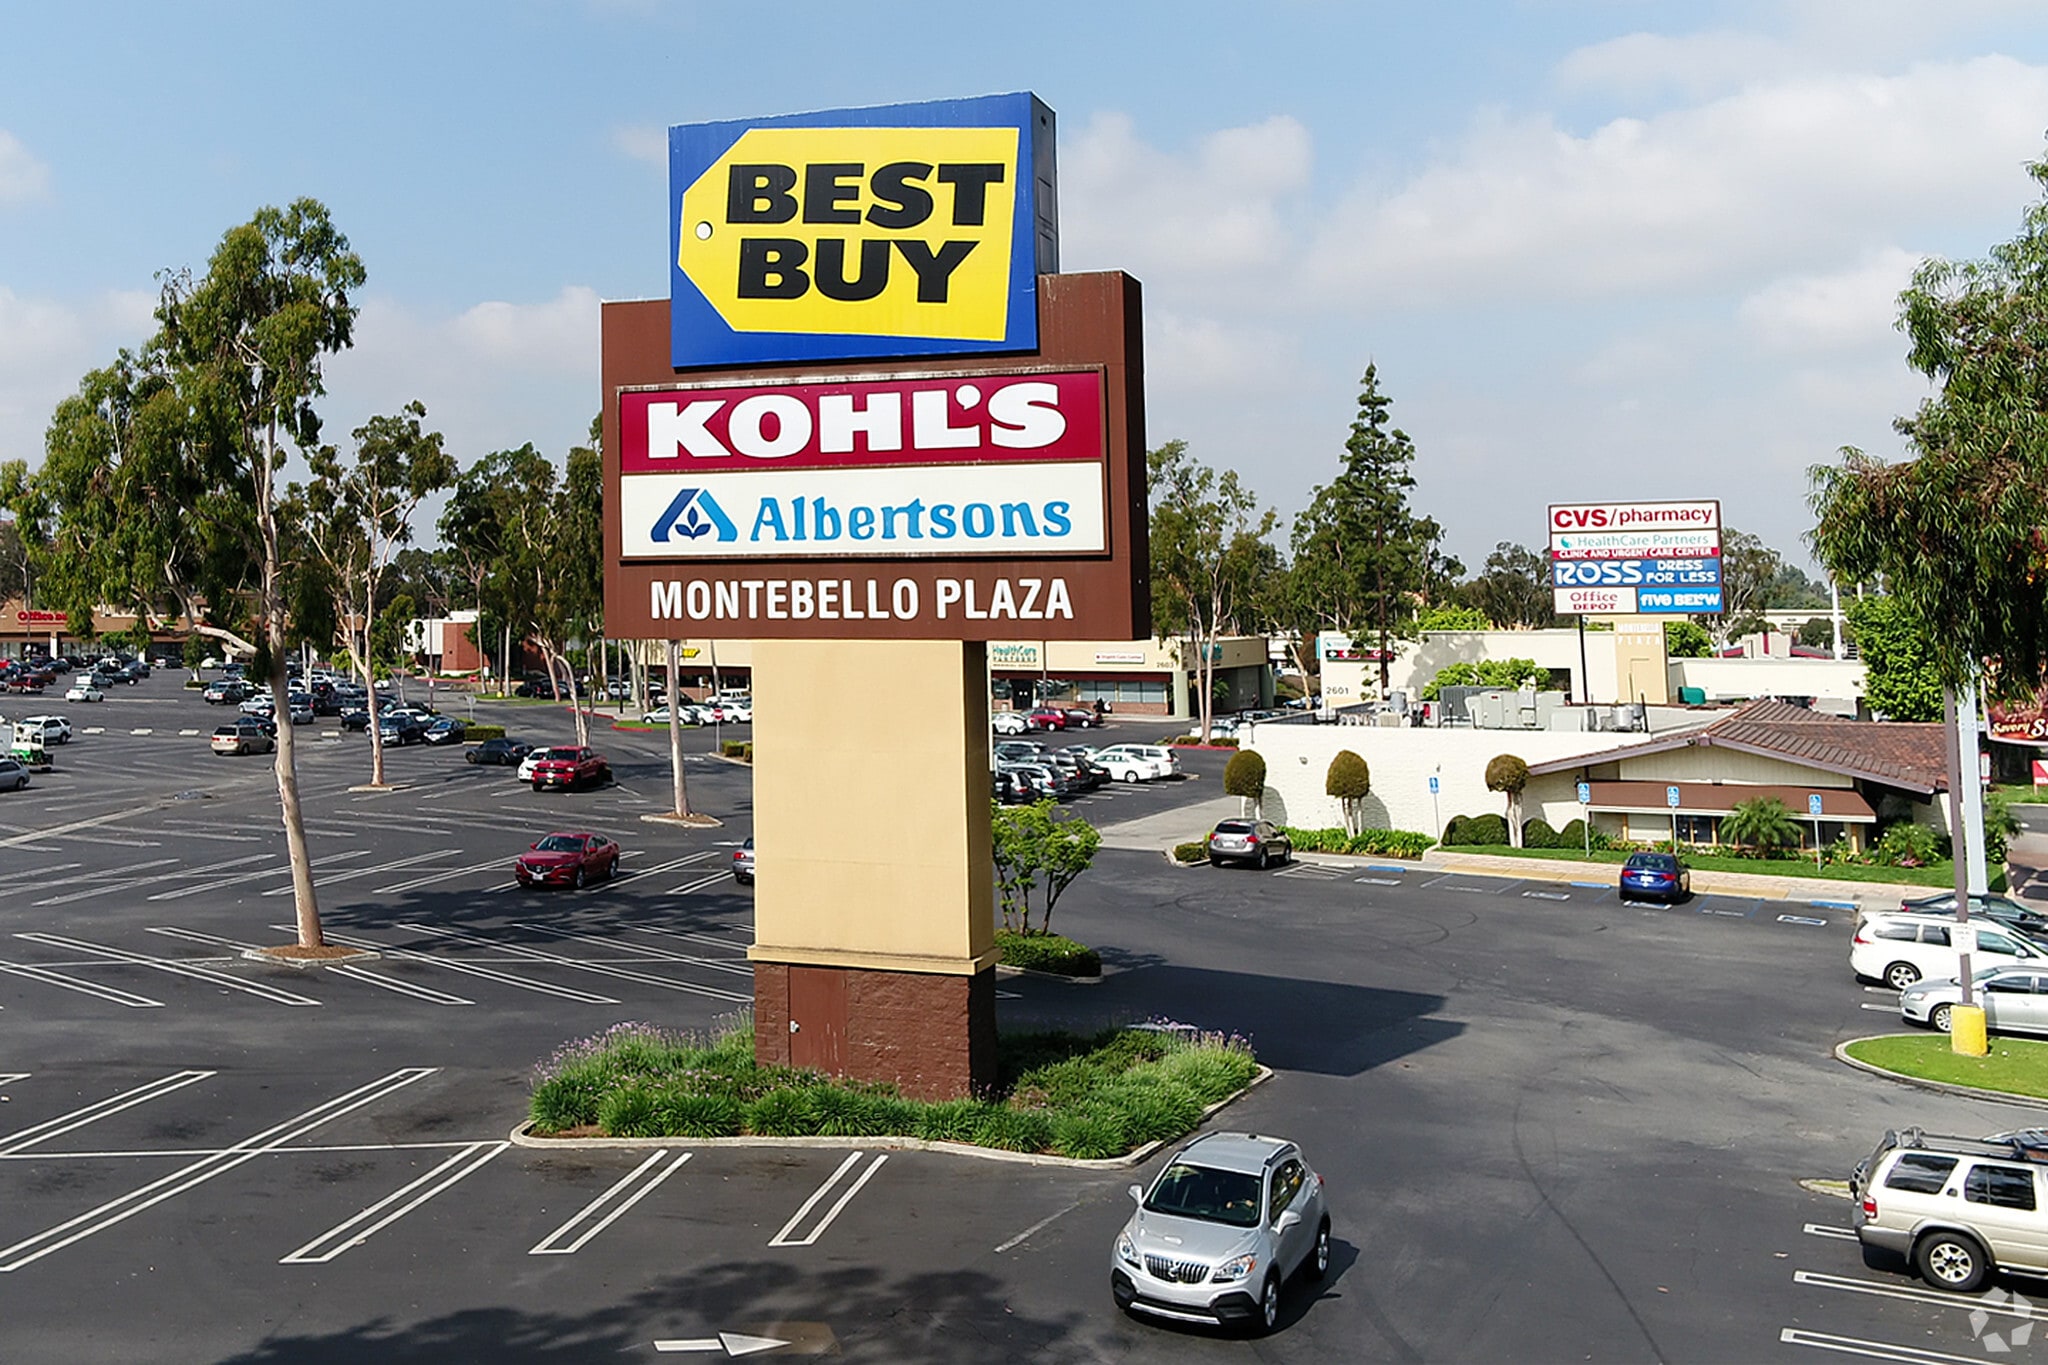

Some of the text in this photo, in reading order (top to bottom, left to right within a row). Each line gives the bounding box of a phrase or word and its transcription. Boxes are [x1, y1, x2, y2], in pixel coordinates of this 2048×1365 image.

[726, 161, 1006, 229] BEST
[737, 238, 981, 304] BUY
[647, 382, 1068, 459] KOHL'S
[750, 495, 1072, 543] Albertsons
[1577, 534, 1709, 547] HealthCare Partners
[1558, 546, 1712, 559] CLINIC AND URGENT CARE CENTER
[1657, 559, 1704, 571] DRESS
[1555, 560, 1643, 585] ROSS
[1646, 571, 1717, 583] FOR LESS
[650, 578, 1075, 620] MONTEBELLO PLAZA
[1570, 591, 1619, 602] Office
[1572, 602, 1617, 610] DEPOT
[1326, 686, 1349, 695] 2601
